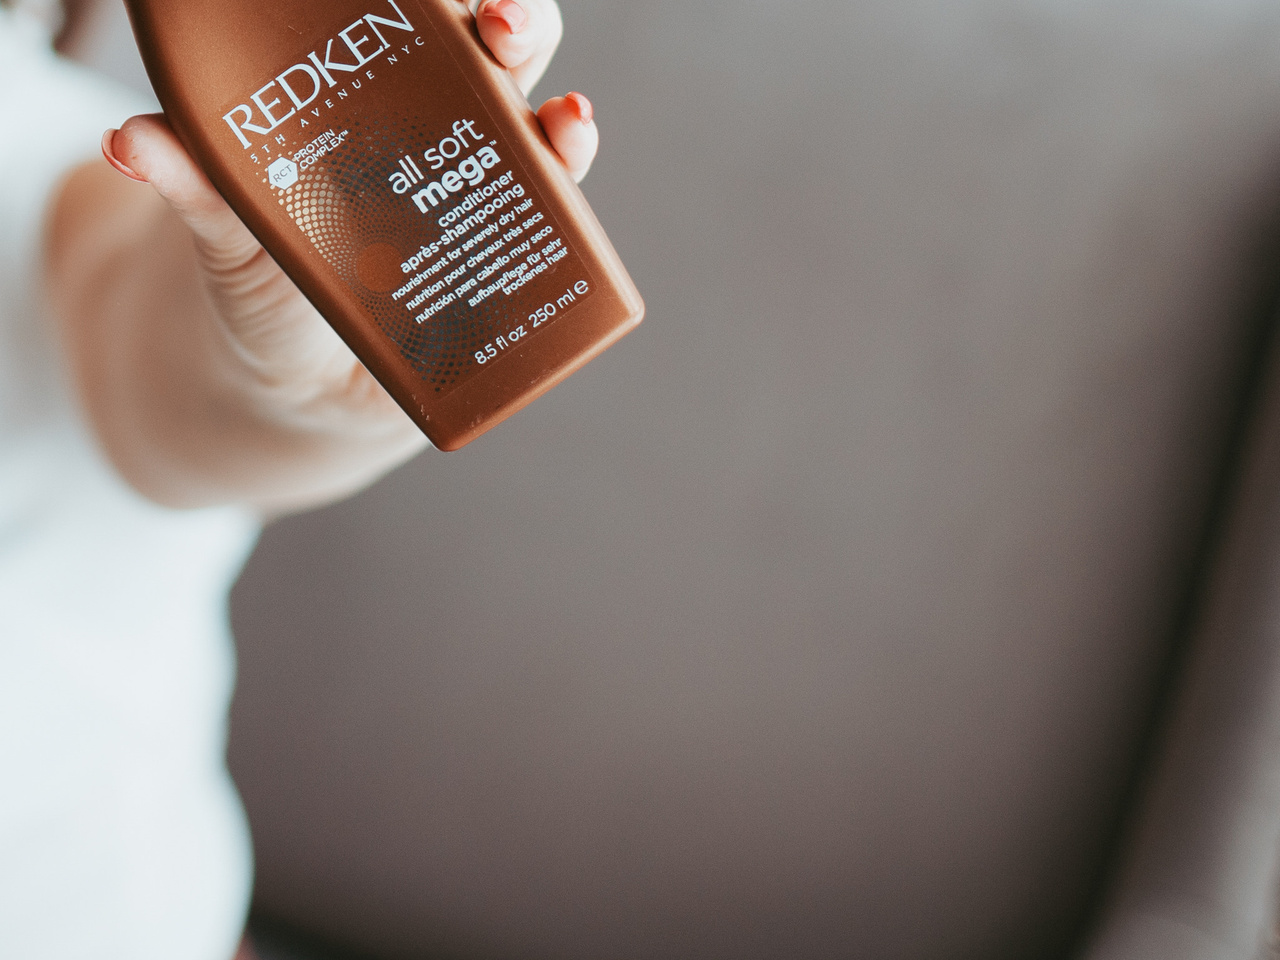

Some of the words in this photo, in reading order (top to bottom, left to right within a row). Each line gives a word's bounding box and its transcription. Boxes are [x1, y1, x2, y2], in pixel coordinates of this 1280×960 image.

[250, 134, 285, 161] 5TH
[300, 70, 374, 128] AVENUE
[387, 36, 424, 65] NYC
[272, 164, 292, 182] RCT
[293, 129, 335, 162] PROTEIN
[388, 155, 424, 194] all
[424, 119, 484, 169] soft
[400, 183, 525, 273] après-shampooing
[438, 170, 513, 227] conditioner
[391, 257, 449, 300] nourishment
[446, 247, 462, 261] for
[461, 222, 498, 251] severely
[499, 210, 515, 225] dry
[513, 198, 533, 214] hair
[406, 280, 445, 310] nutrition
[444, 264, 466, 285] pour
[466, 238, 505, 267] cheveux
[503, 226, 523, 241] très
[522, 212, 543, 229] secs
[415, 293, 456, 324] nutrición
[454, 278, 477, 297] para
[476, 255, 510, 281] cabello
[509, 240, 530, 258] muy
[530, 225, 553, 243] seco
[468, 262, 531, 307] aufbaupflege
[526, 252, 541, 265] für
[541, 238, 561, 256] sehr
[501, 262, 548, 295] trockenes
[545, 246, 568, 265] haar
[474, 343, 497, 364] 8.5
[495, 335, 508, 350] fl
[508, 325, 527, 341] oz
[528, 303, 556, 327] 250
[556, 289, 575, 308] ml
